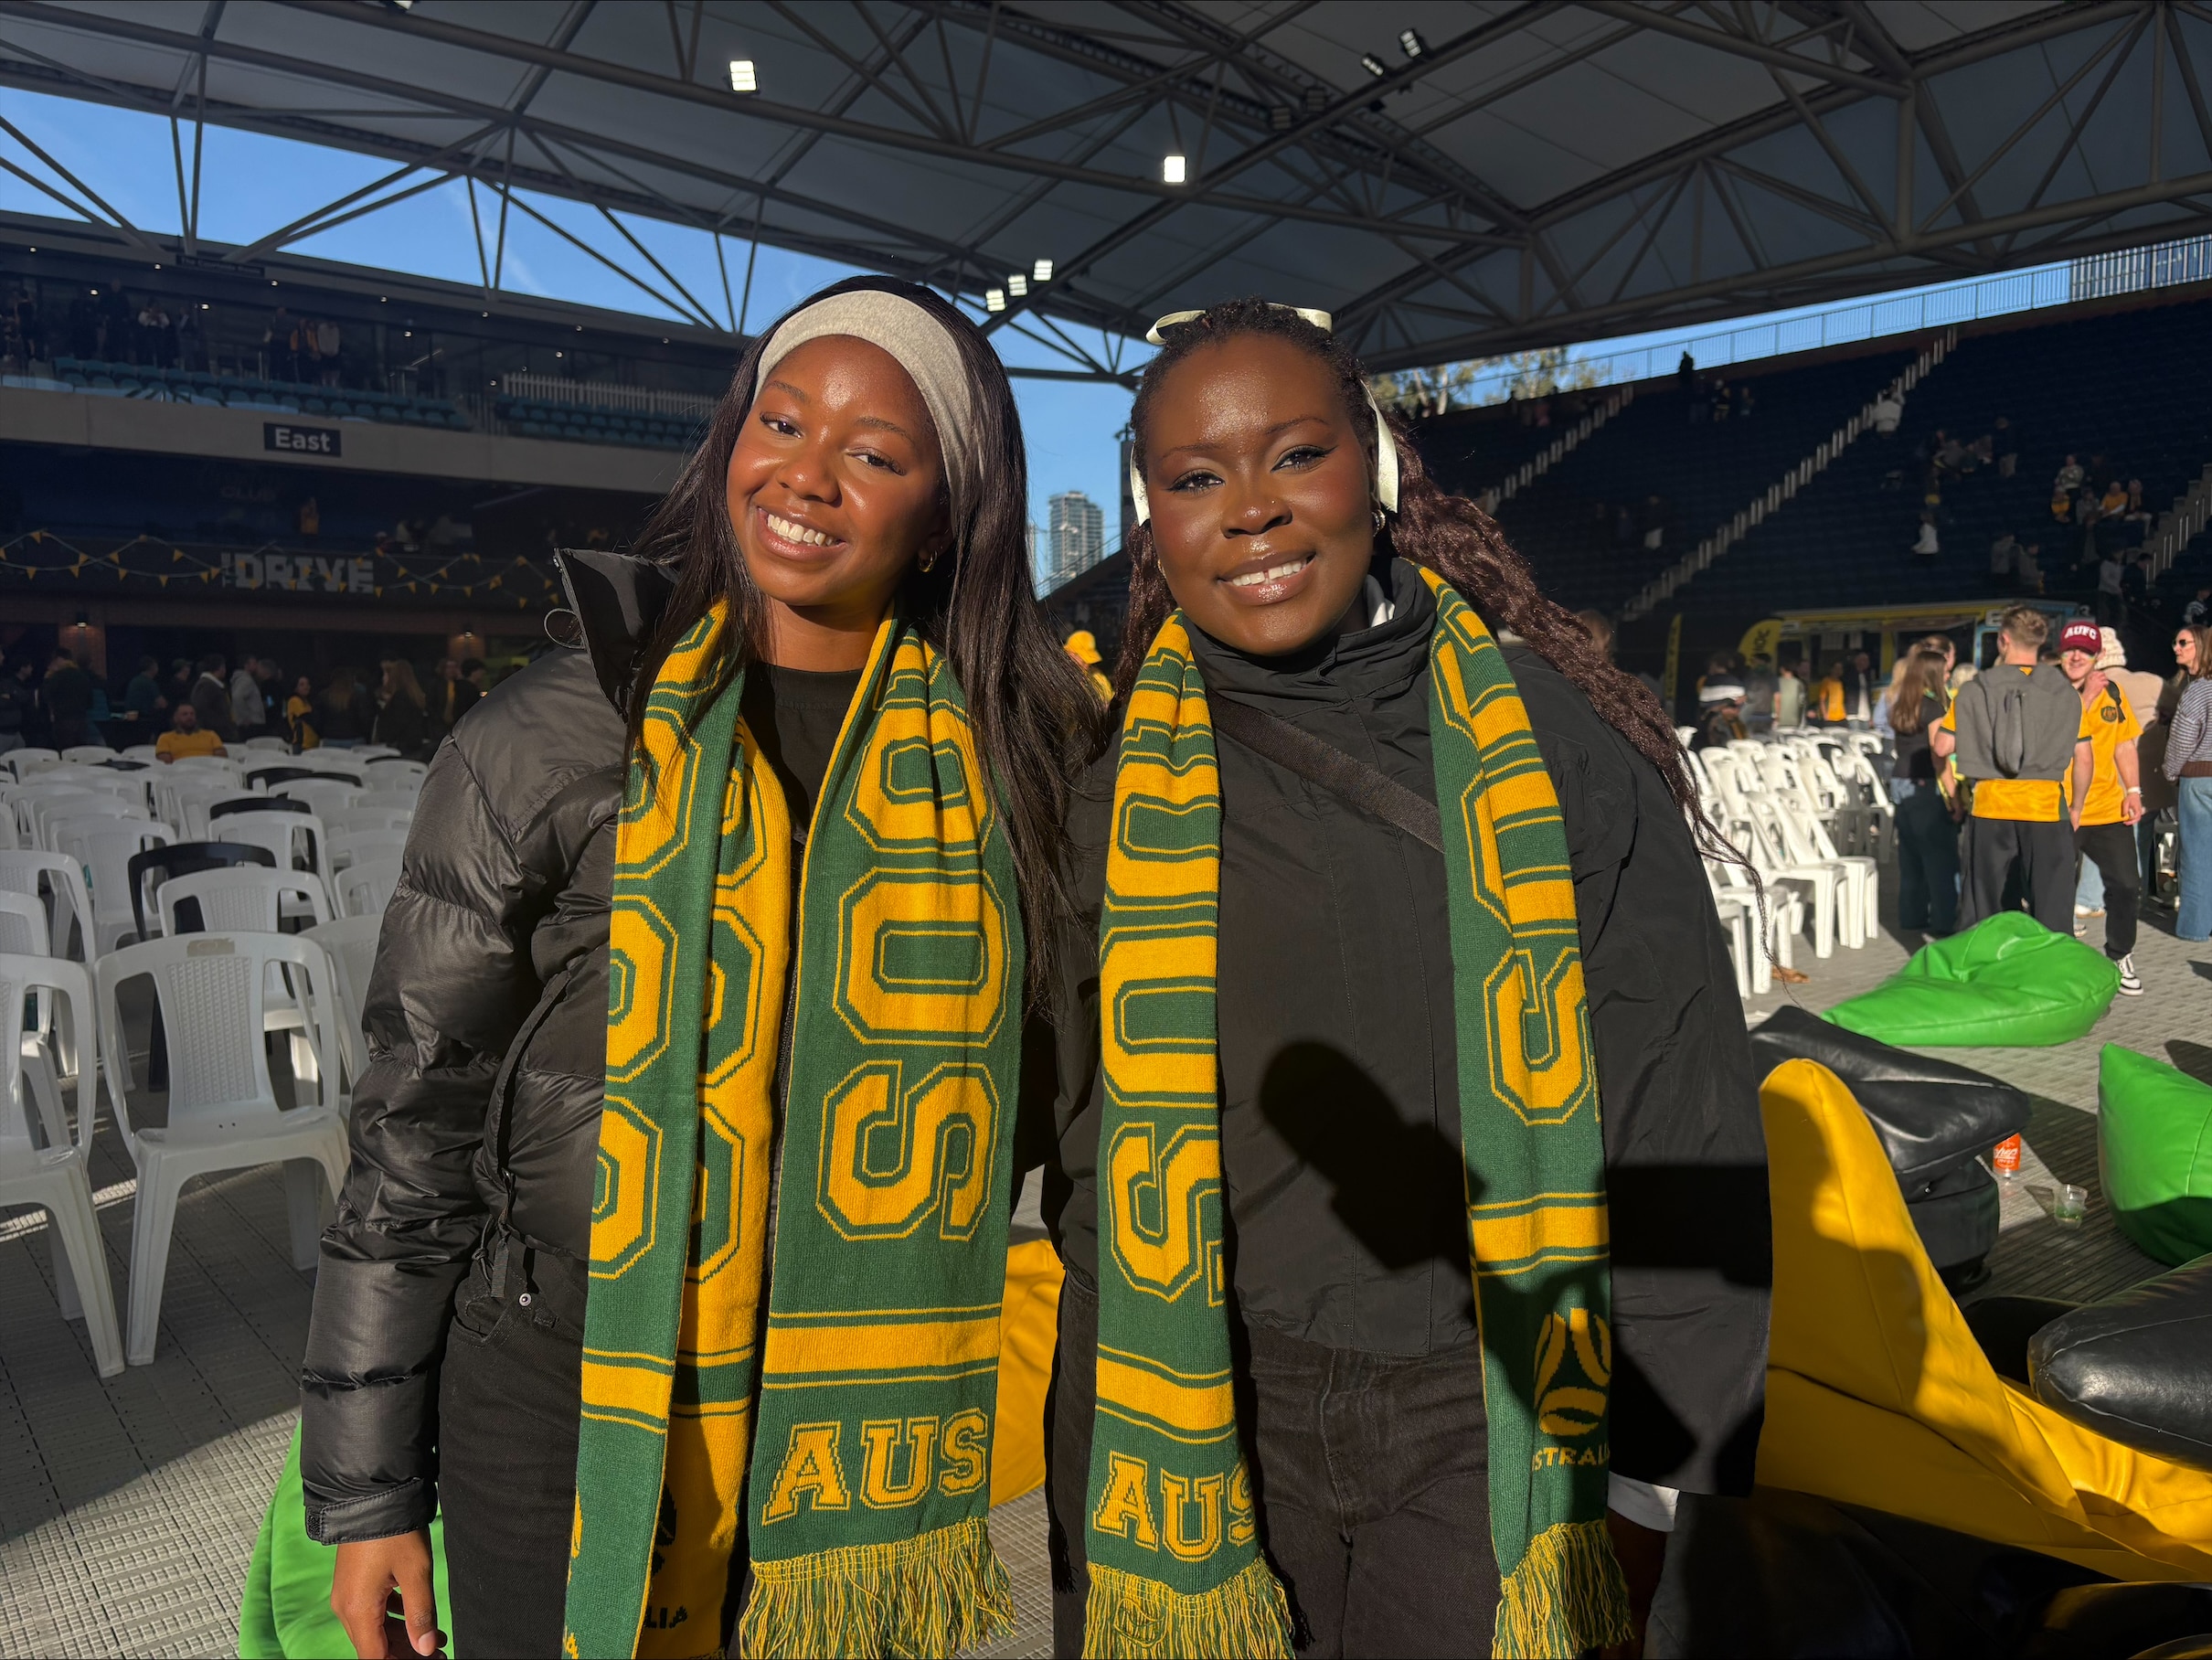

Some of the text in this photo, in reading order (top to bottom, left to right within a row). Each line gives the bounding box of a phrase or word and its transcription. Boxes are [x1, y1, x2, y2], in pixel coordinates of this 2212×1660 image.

[275, 427, 331, 452] East
[235, 553, 374, 594] DRIVE
[761, 1407, 988, 1526] AUS
